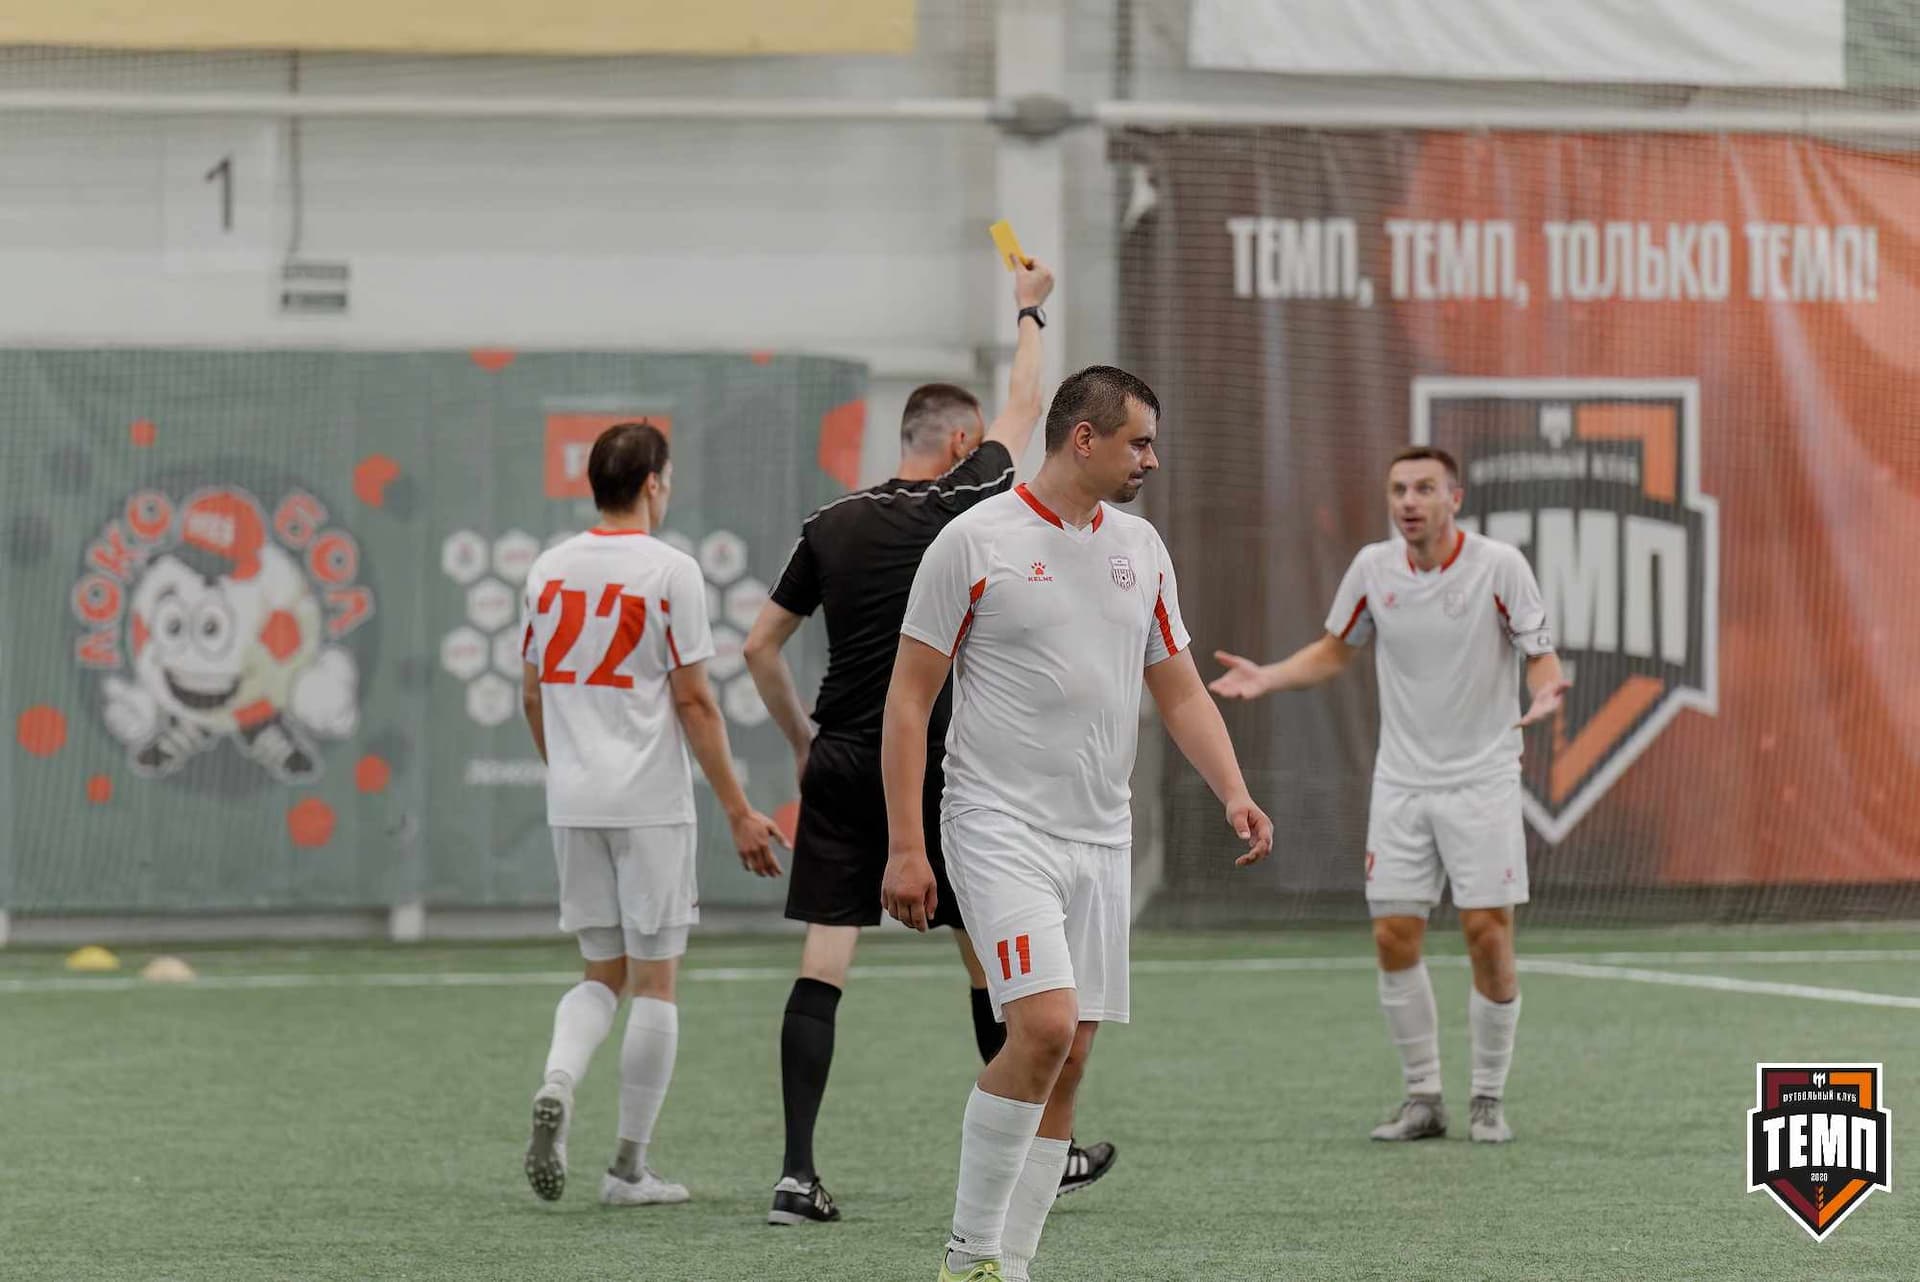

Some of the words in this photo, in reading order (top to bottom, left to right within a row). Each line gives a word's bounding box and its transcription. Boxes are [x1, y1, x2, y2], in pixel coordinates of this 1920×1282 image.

[205, 157, 233, 233] 1
[1227, 215, 1374, 309] ТЕМП,
[1385, 218, 1530, 309] ТЕМП,
[1542, 219, 1732, 303] ТОЛЬКО
[1743, 221, 1879, 303] ТЕМП!
[537, 579, 647, 689] 22
[1456, 507, 1689, 667] МП
[997, 934, 1032, 981] 11
